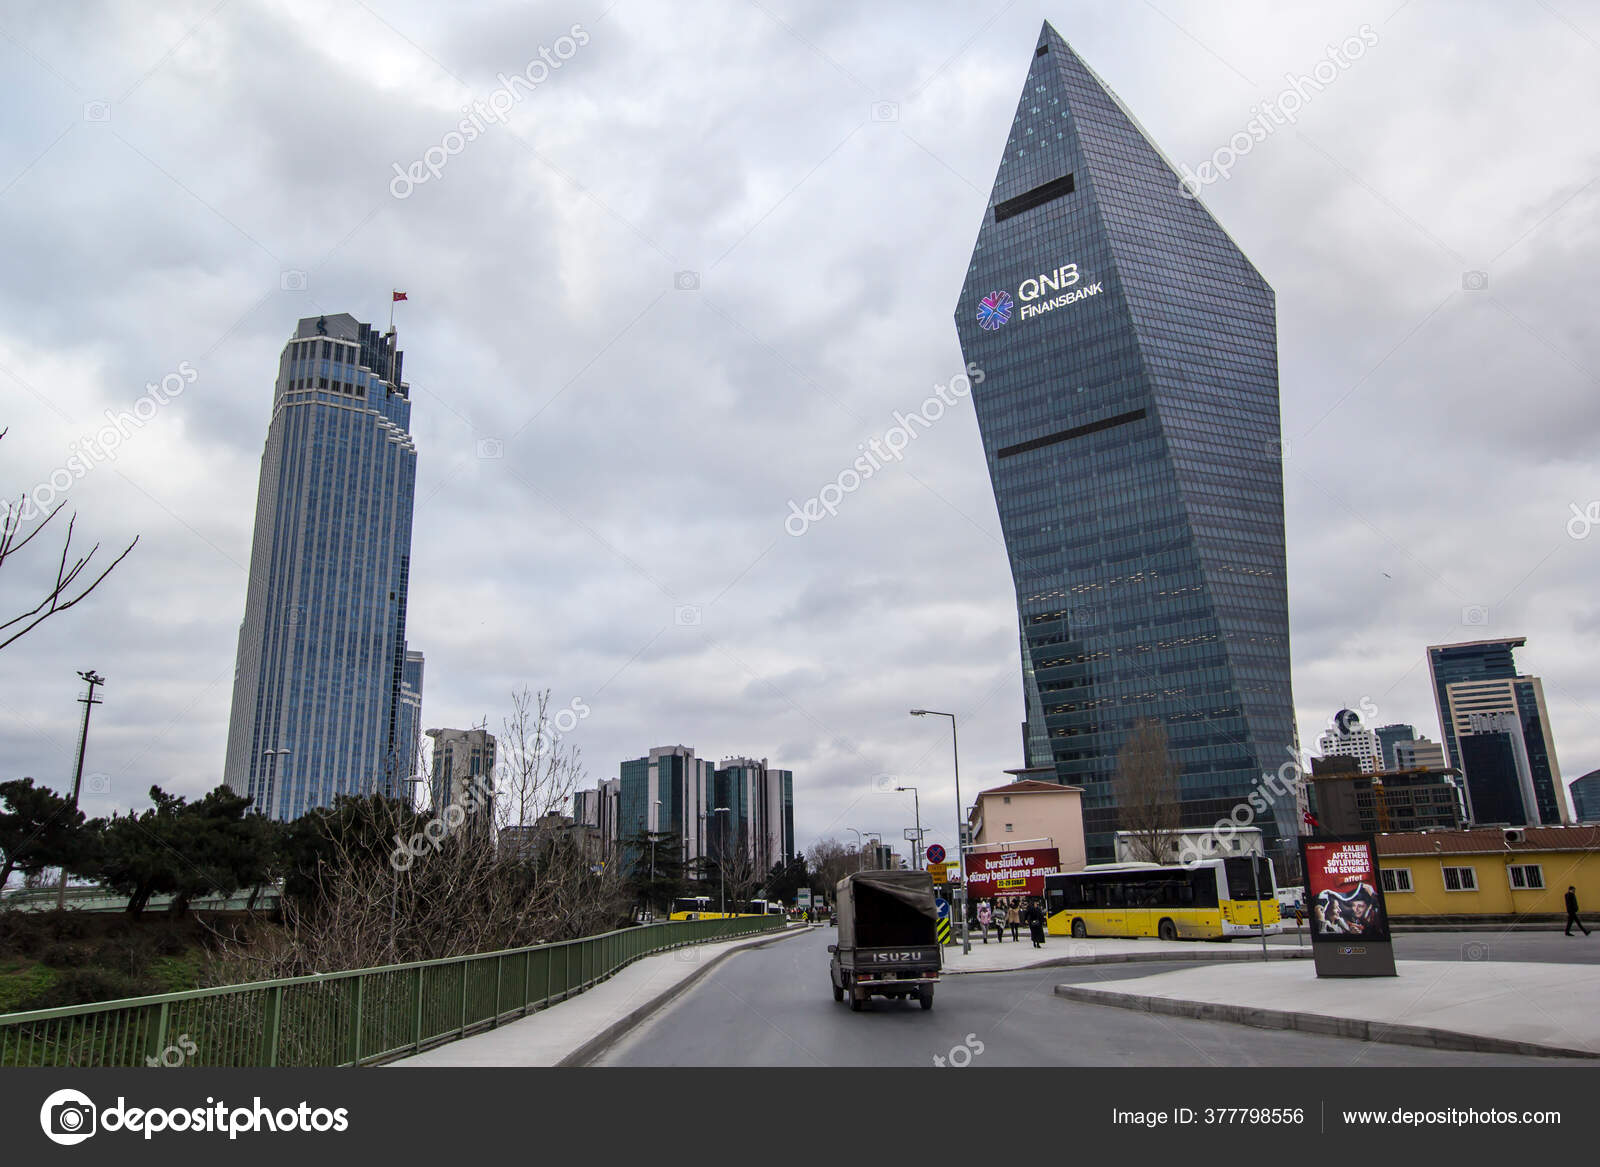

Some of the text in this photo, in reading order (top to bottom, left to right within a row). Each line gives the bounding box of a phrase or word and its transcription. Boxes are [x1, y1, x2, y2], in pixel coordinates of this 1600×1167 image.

[1018, 263, 1080, 301] QNB
[1020, 282, 1103, 320] FINANSBANK
[985, 856, 1035, 869] bursluluk ve
[969, 871, 991, 884] düzey
[991, 868, 1031, 881] belirleme
[873, 951, 921, 962] ISUZU
